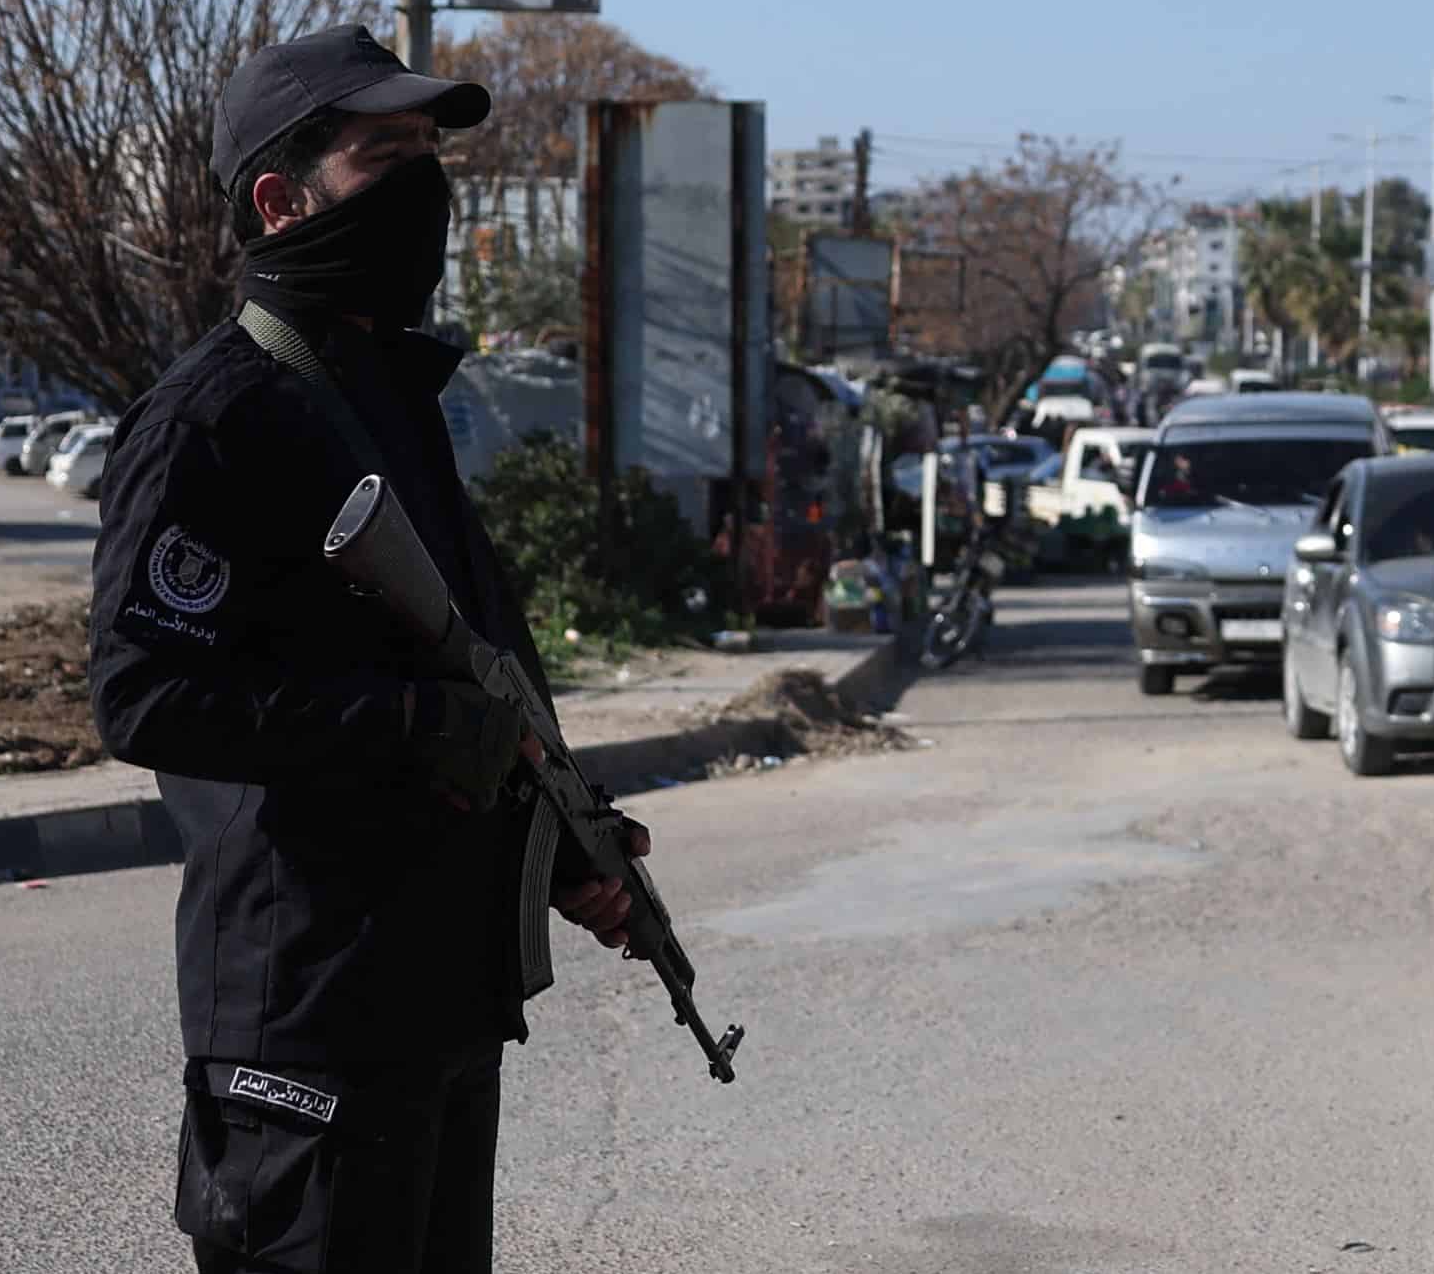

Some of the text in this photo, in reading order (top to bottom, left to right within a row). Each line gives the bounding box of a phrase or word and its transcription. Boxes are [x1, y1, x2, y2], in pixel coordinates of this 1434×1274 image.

[237, 1074, 331, 1118] إدارة الأمن العام
